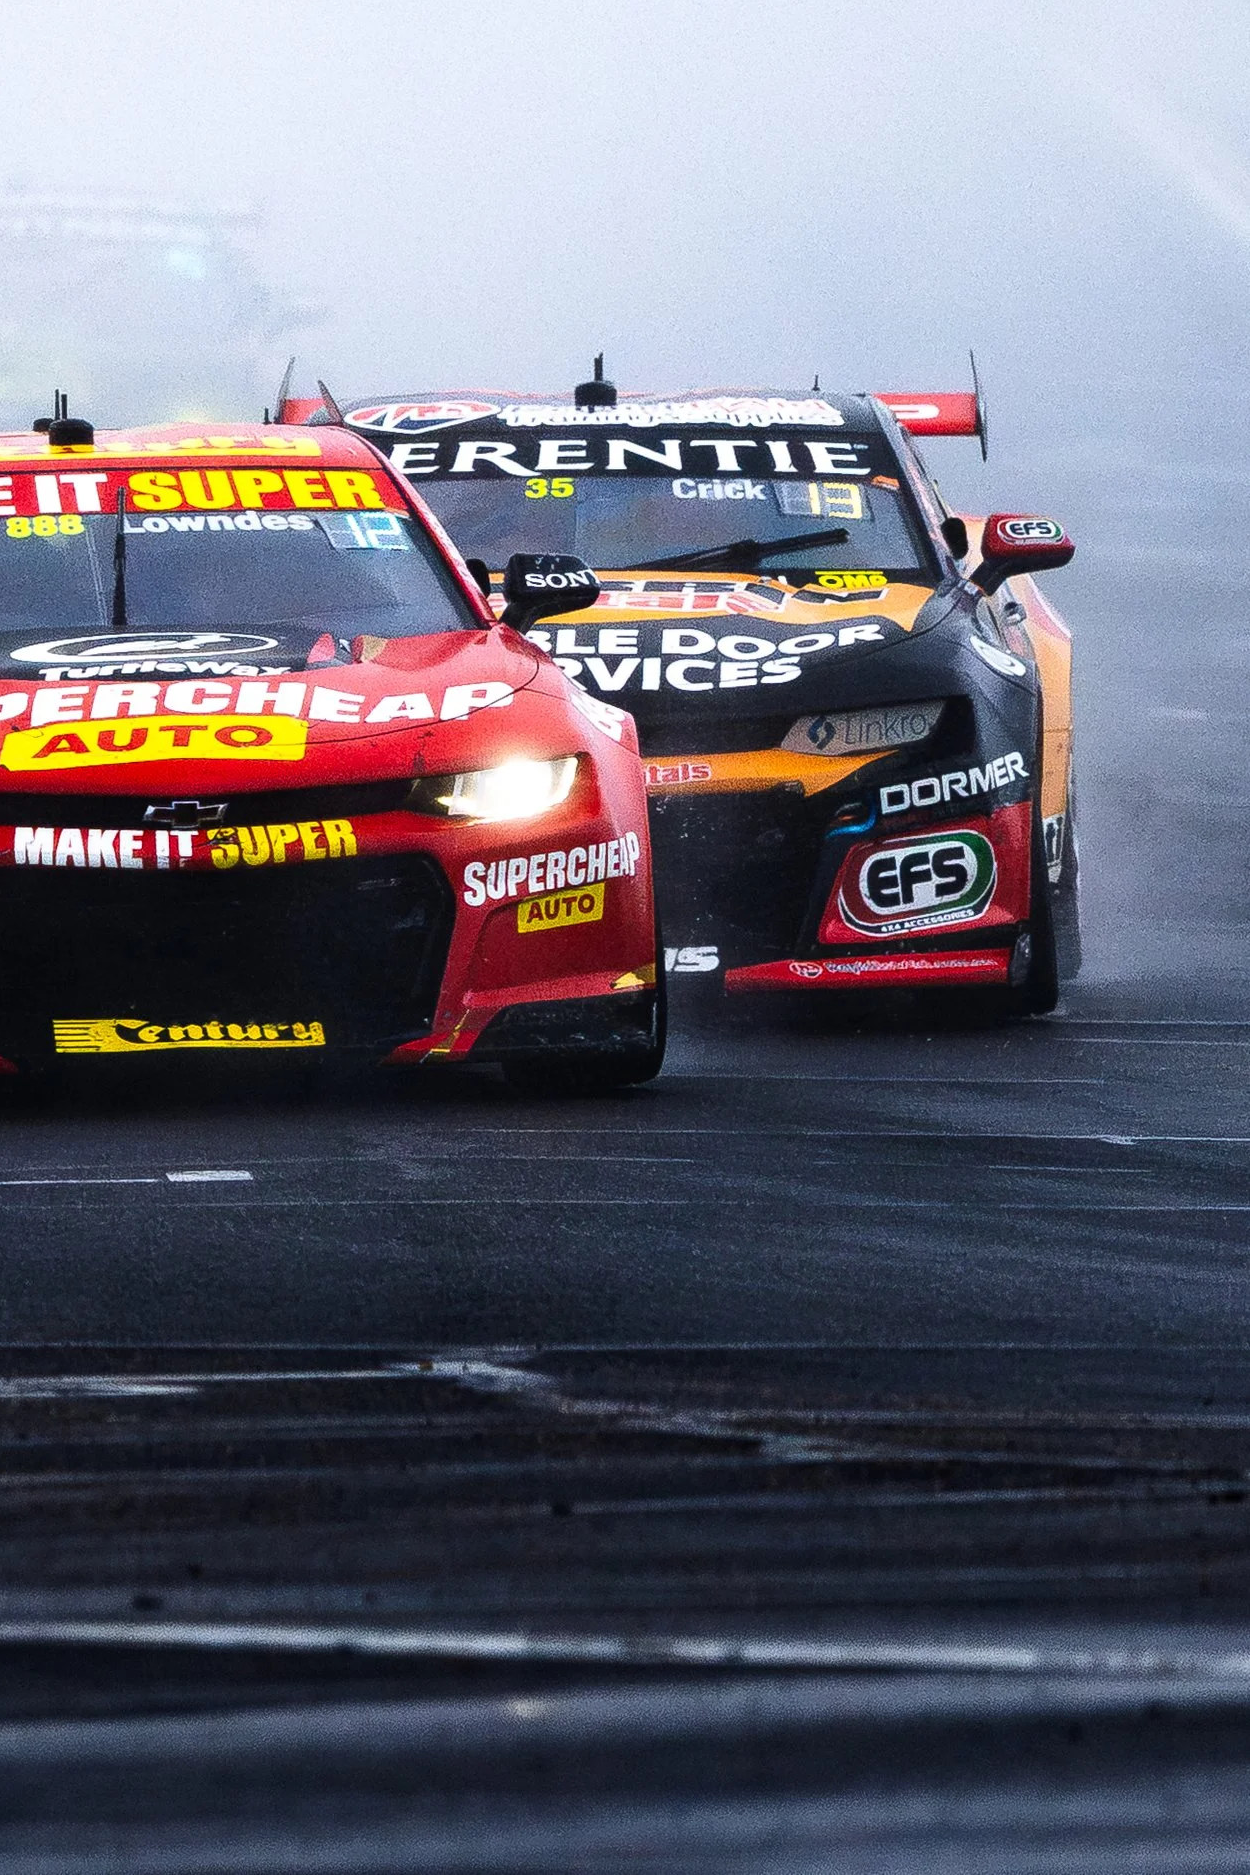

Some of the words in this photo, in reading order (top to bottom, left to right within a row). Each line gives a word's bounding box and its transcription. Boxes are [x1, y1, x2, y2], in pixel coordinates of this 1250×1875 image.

[34, 473, 108, 514] IT
[128, 469, 386, 510] SUPER
[524, 477, 575, 499] 35
[671, 478, 769, 501] Crick
[5, 514, 85, 538] 888
[123, 511, 316, 534] Lowndes
[1009, 521, 1052, 536] EFS
[818, 573, 888, 590] OMP
[661, 624, 886, 661] DOOR
[32, 725, 273, 759] AUTO
[879, 751, 1030, 815] DORMER
[14, 827, 144, 869] MAKE
[155, 830, 199, 869] IT
[206, 819, 358, 869] SUPER
[463, 831, 641, 907] SUPERCHEAP
[866, 846, 968, 908] EFS
[526, 893, 596, 923] AUTO
[52, 1019, 327, 1053] Century
